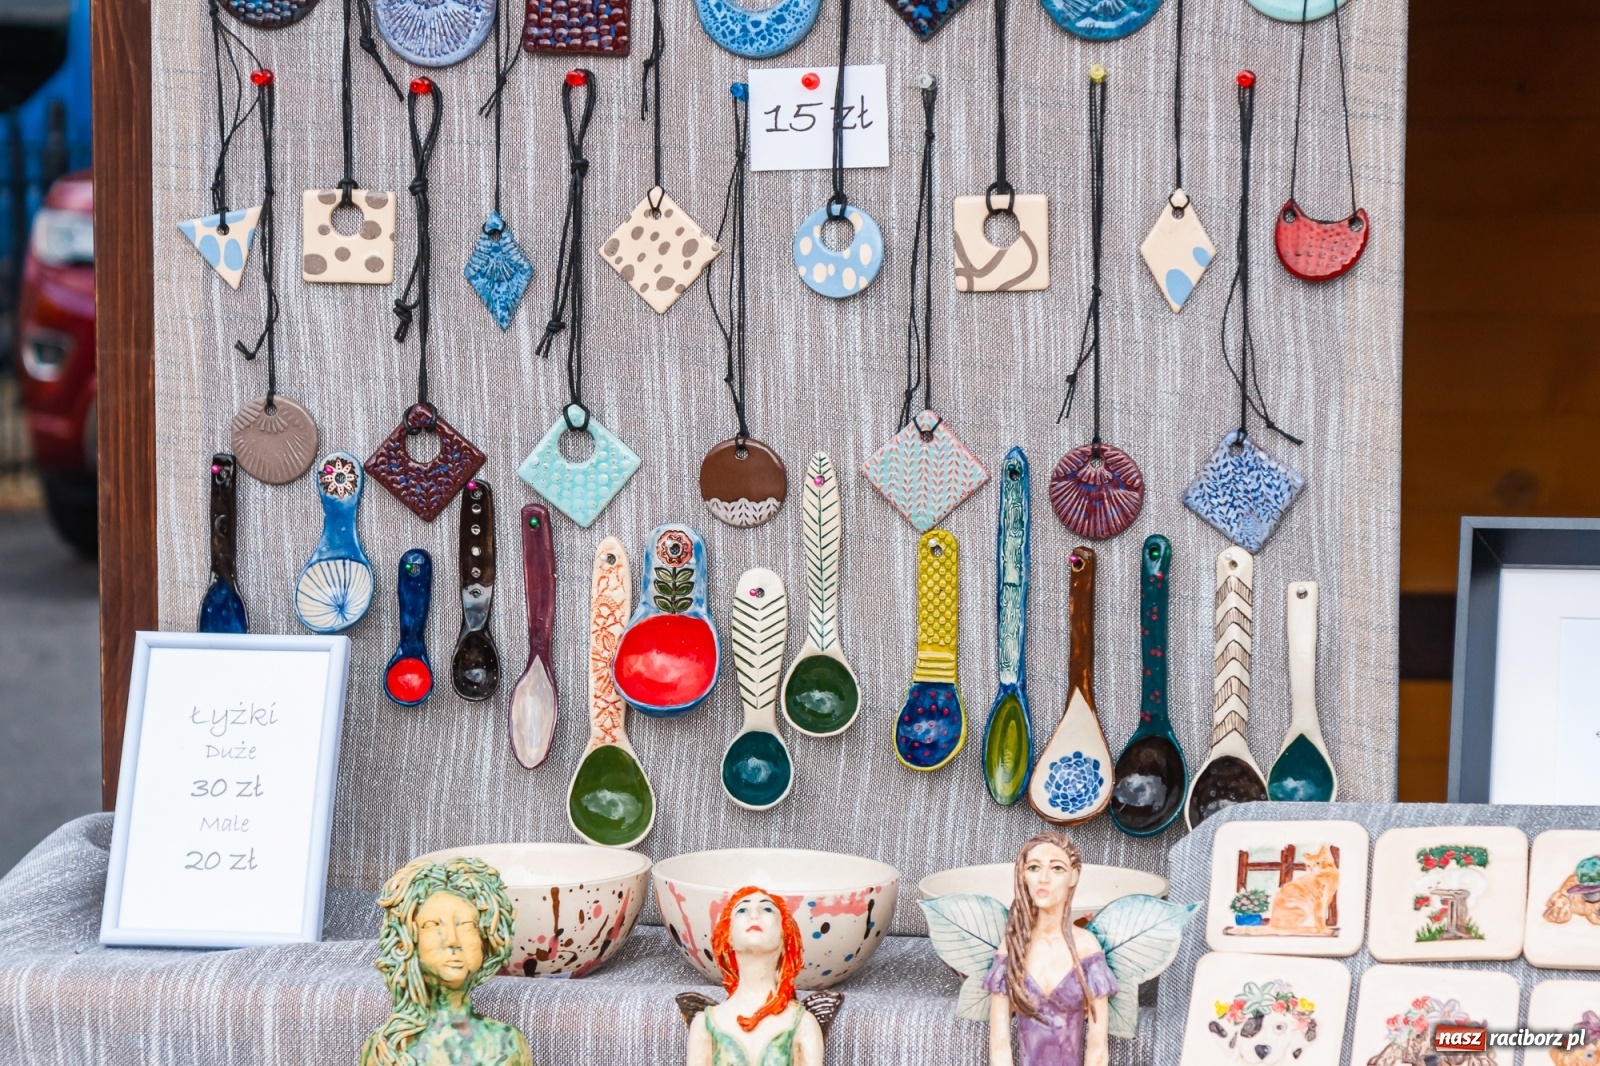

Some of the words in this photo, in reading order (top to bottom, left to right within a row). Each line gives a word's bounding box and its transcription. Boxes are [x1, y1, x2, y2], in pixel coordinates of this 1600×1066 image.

[764, 102, 823, 132] 15
[830, 94, 873, 130] zł
[188, 701, 278, 738] Łyżki
[205, 741, 257, 760] Duże
[190, 778, 228, 798] 30
[235, 774, 264, 798] zł
[199, 814, 249, 833] Małe
[184, 850, 221, 871] 20
[229, 847, 258, 871] zł
